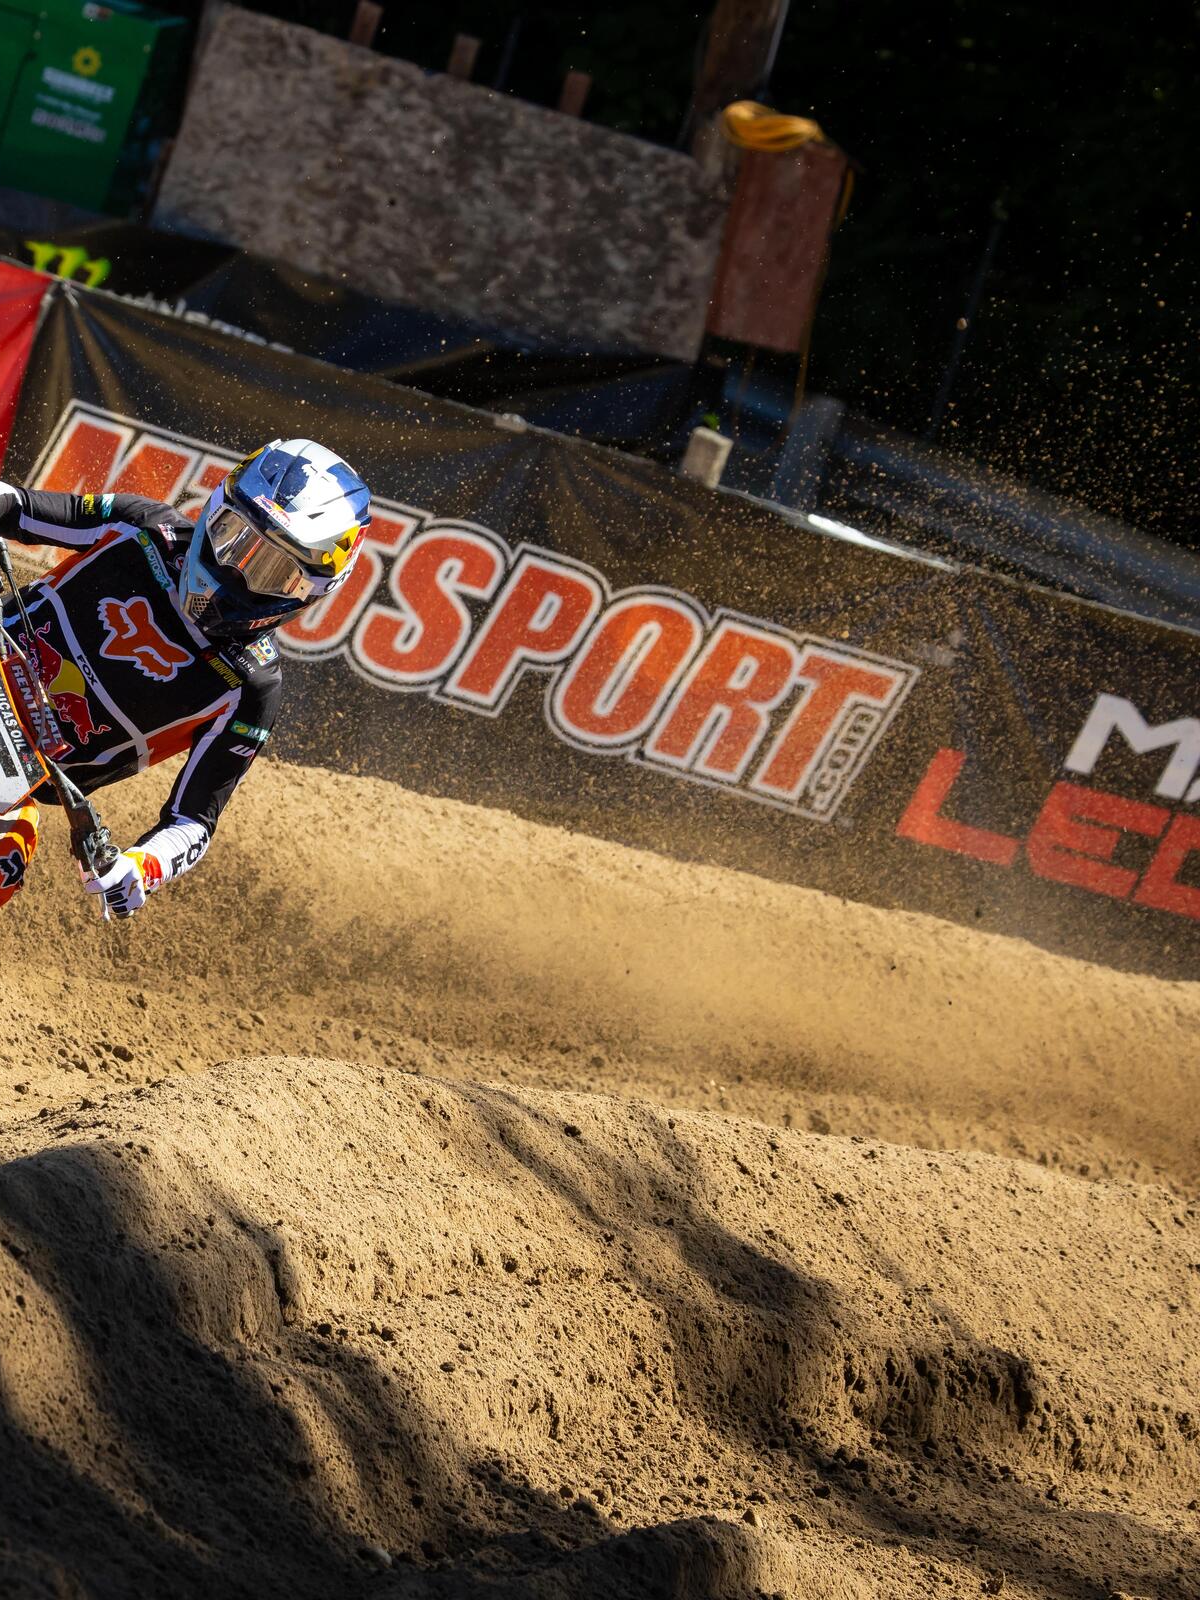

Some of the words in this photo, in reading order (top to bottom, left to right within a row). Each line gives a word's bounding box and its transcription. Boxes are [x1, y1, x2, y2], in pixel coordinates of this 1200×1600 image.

[0, 412, 905, 802] MOSPORT
[75, 653, 99, 687] FOX
[227, 645, 256, 674] ARADISE
[11, 663, 51, 751] RENTHAL
[10, 728, 28, 753] OIL
[1064, 692, 1200, 804] M
